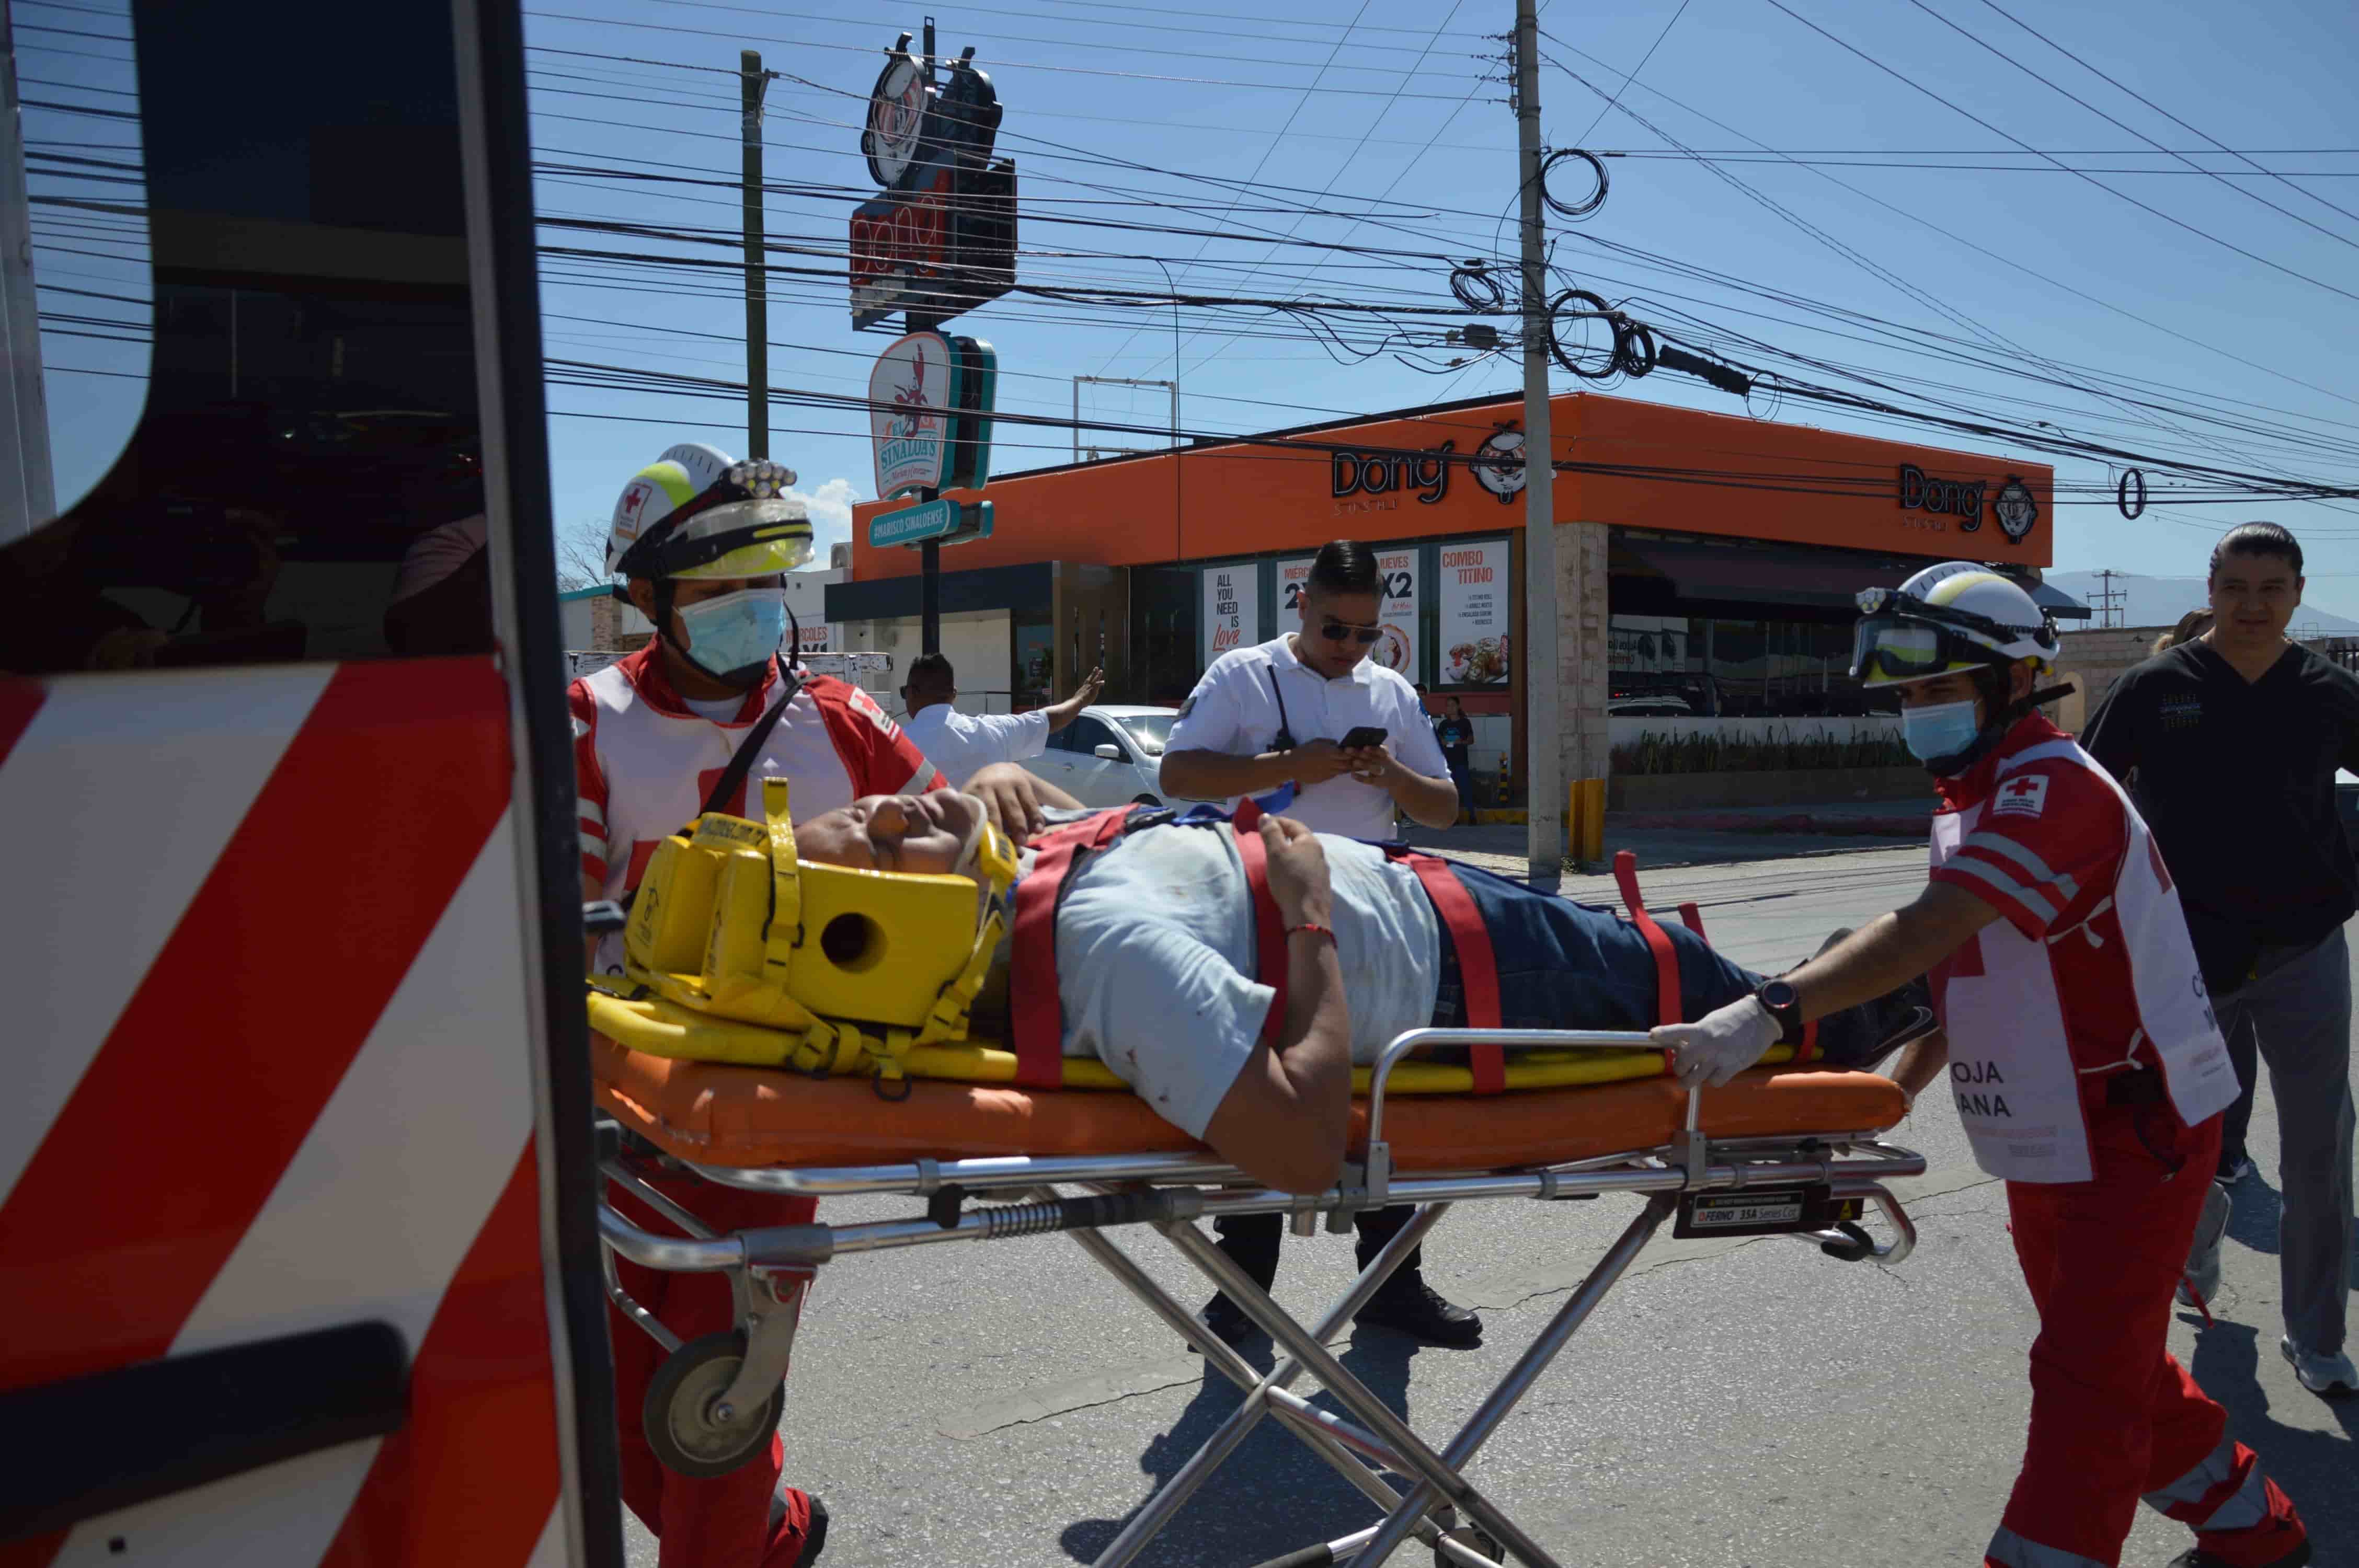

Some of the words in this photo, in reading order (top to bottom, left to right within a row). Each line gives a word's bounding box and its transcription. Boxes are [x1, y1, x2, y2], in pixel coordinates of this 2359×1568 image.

[1332, 440, 1455, 503] Dong
[1900, 464, 1987, 532] Dong
[874, 516, 904, 539] #MARISCO
[904, 507, 944, 533] SINALOENSE
[1442, 550, 1483, 568] COMBO
[1217, 574, 1231, 587] ALL
[1382, 572, 1413, 598] X2
[1457, 567, 1493, 584] TITINO
[1217, 588, 1233, 601] YOU
[1285, 582, 1306, 609] 2
[1217, 602, 1238, 615] NEED
[1231, 616, 1239, 628] IS
[786, 627, 828, 644] MRCOLES
[1213, 624, 1241, 651] Love
[1952, 1061, 2004, 1083] OJA
[1957, 1093, 2012, 1117] ANA
[1706, 1210, 1734, 1221] FERNO
[1740, 1209, 1757, 1220] 35A
[1758, 1208, 1782, 1219] Series
